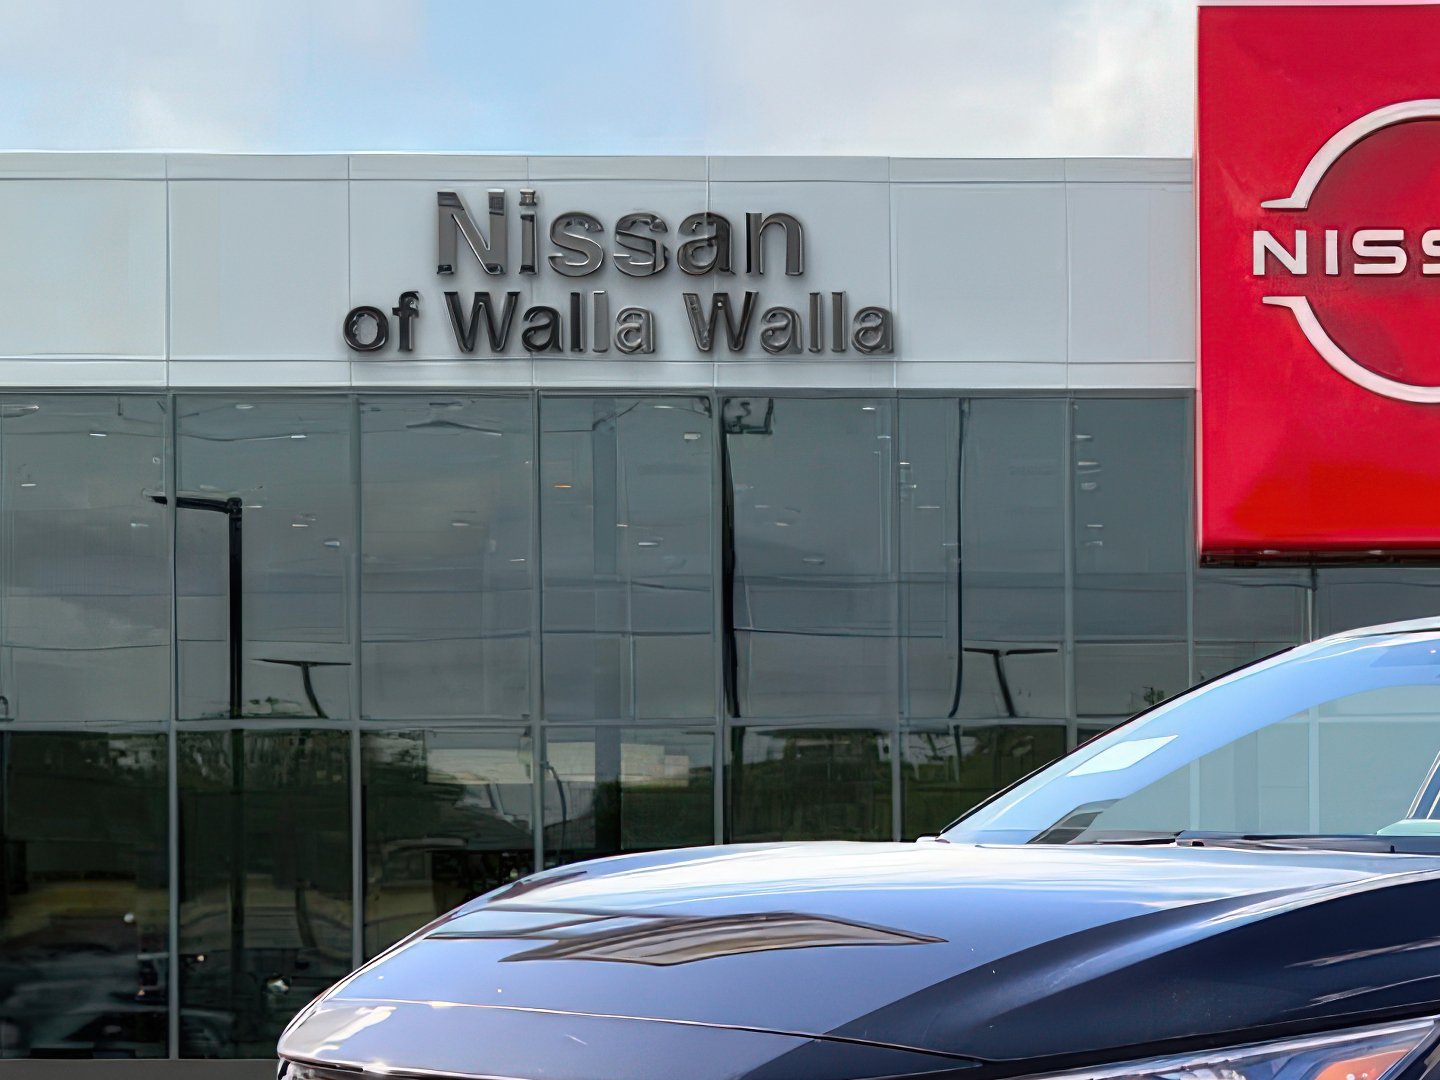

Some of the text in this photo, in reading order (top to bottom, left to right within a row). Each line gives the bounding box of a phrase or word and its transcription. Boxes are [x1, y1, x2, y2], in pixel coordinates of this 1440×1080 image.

[436, 188, 805, 278] Nissan
[342, 290, 895, 355] of Walla Walla
